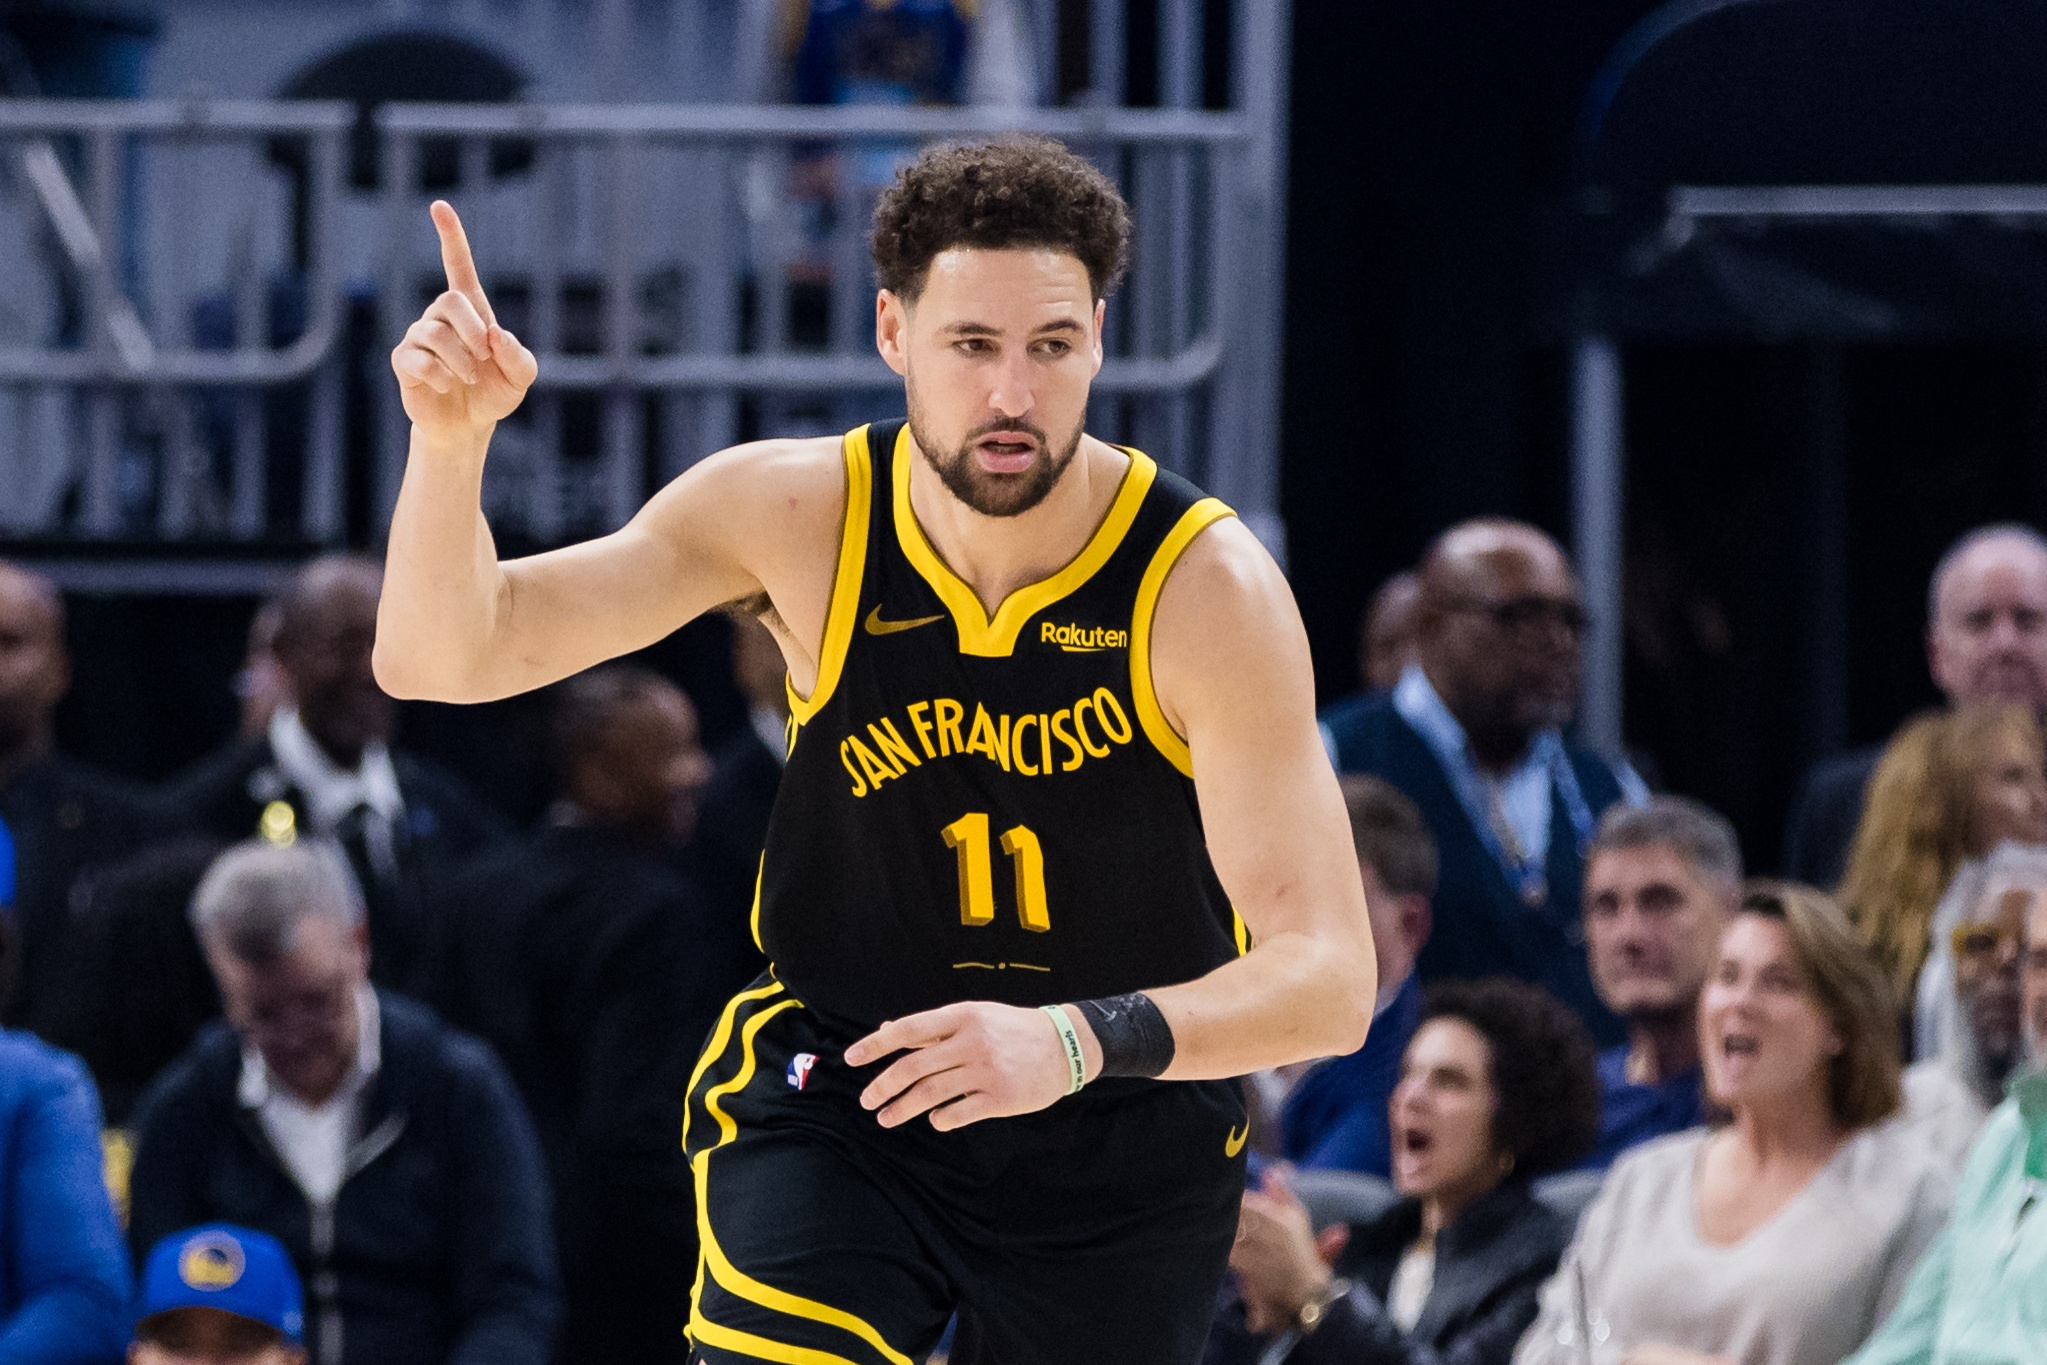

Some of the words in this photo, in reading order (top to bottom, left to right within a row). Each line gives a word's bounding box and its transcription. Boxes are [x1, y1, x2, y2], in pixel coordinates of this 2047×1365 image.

[1041, 621, 1127, 648] Rakuten
[840, 717, 922, 798] SAN
[907, 687, 1133, 776] FRANCISCO
[941, 812, 1051, 933] 11
[1065, 1030, 1080, 1058] hearts
[1074, 1059, 1083, 1075] our
